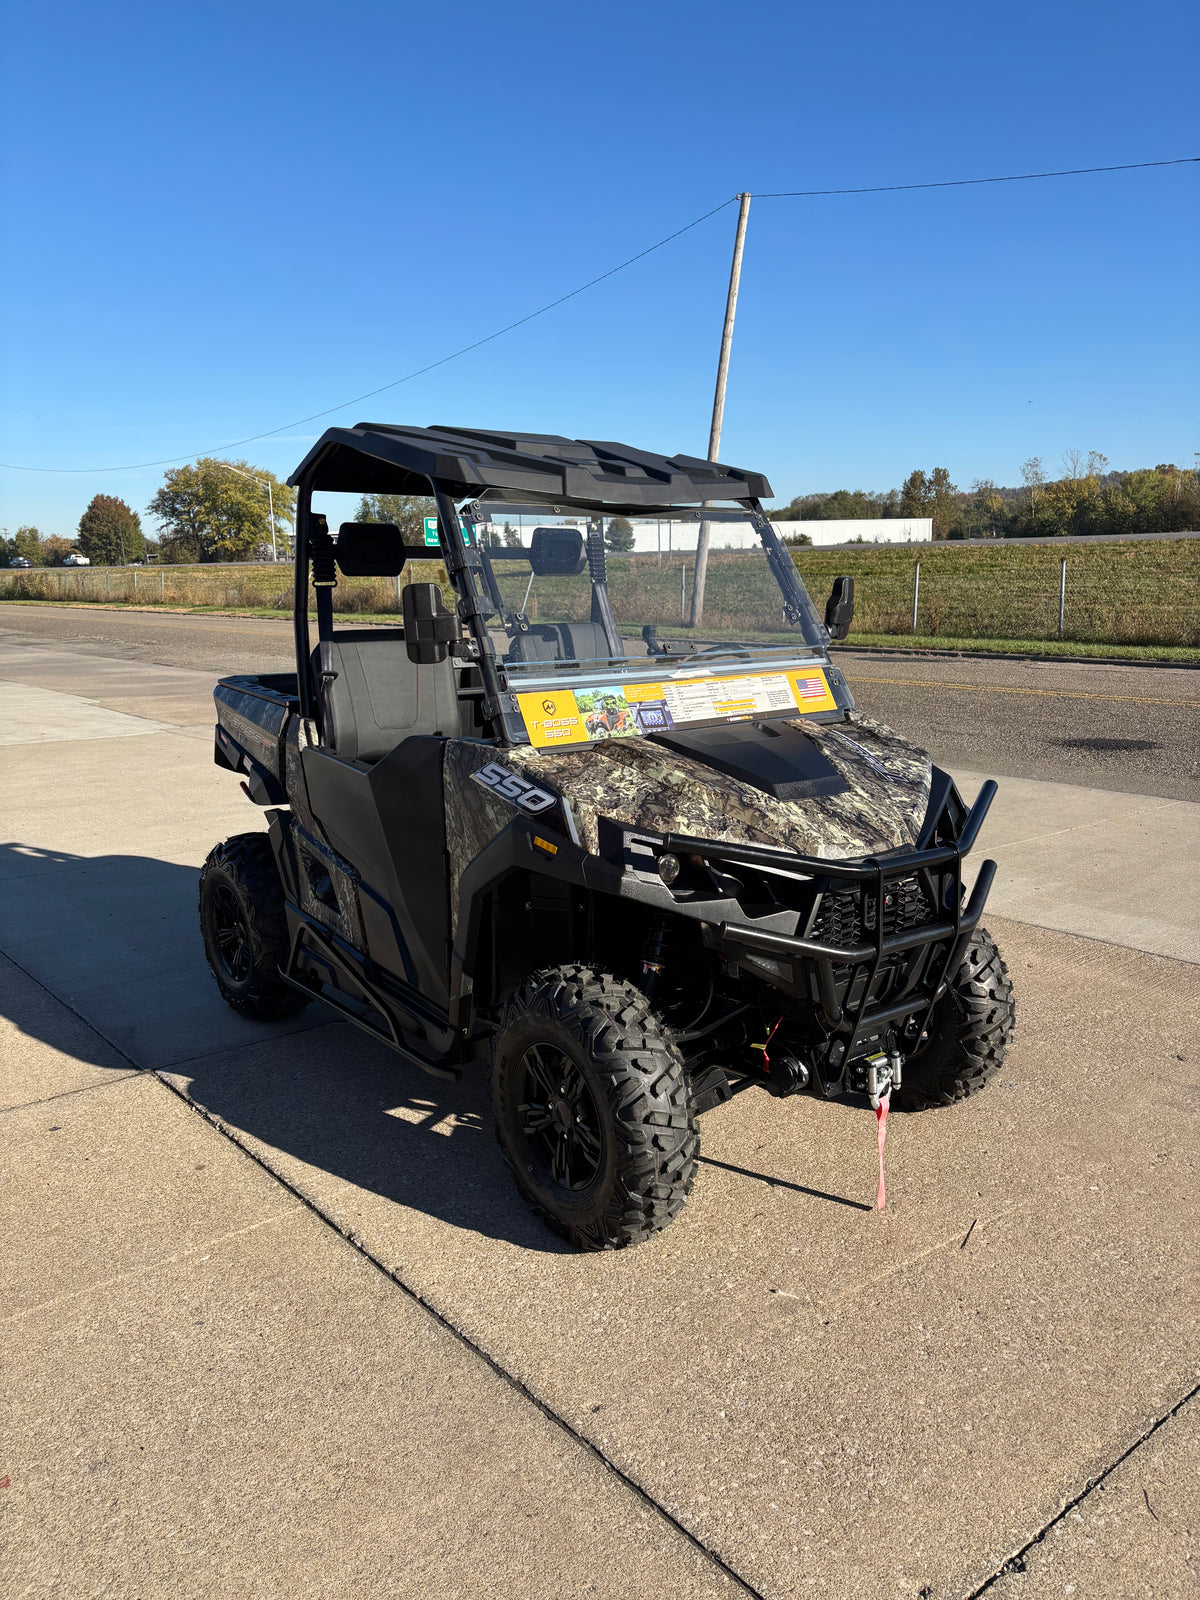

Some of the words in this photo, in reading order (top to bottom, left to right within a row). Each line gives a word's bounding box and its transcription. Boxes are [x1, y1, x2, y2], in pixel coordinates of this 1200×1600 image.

[531, 717, 578, 729] T-BOSS
[545, 728, 571, 738] 550
[474, 762, 556, 812] 550
